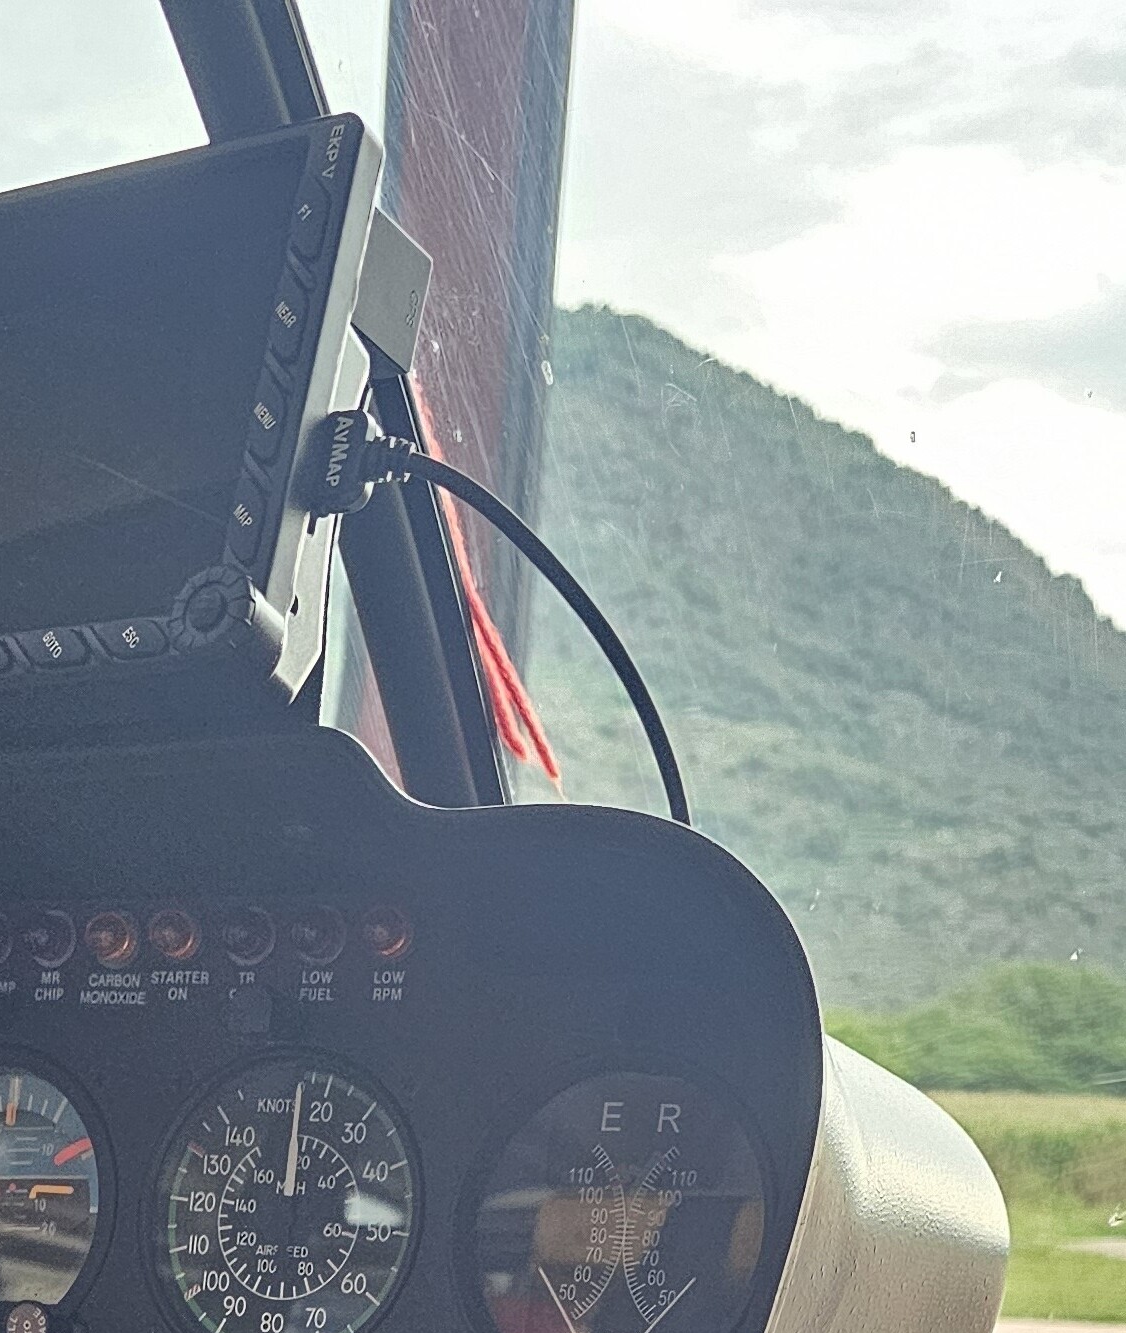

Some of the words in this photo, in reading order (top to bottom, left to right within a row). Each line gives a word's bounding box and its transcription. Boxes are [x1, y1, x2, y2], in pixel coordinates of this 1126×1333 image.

[274, 300, 297, 329] NEAR
[253, 401, 277, 430] MENU
[325, 415, 356, 488] AVMAP
[232, 503, 253, 527] MAP
[121, 625, 140, 649] ESC
[88, 973, 141, 988] CARBON
[150, 971, 210, 985] STARTER
[301, 971, 334, 985] LOW
[373, 971, 406, 985] LOW
[80, 989, 147, 1006] MONOXIDE
[309, 1101, 333, 1123] 20
[225, 1126, 255, 1147] 140
[341, 1122, 367, 1144] 30
[203, 1155, 231, 1175] 130
[362, 1161, 389, 1183] 40
[189, 1192, 216, 1213] 120
[188, 1235, 210, 1255] 110
[202, 1271, 230, 1292] 100
[340, 1273, 367, 1294] 60
[223, 1296, 247, 1317] 90
[260, 1312, 284, 1333] 80
[304, 1307, 327, 1329] 70
